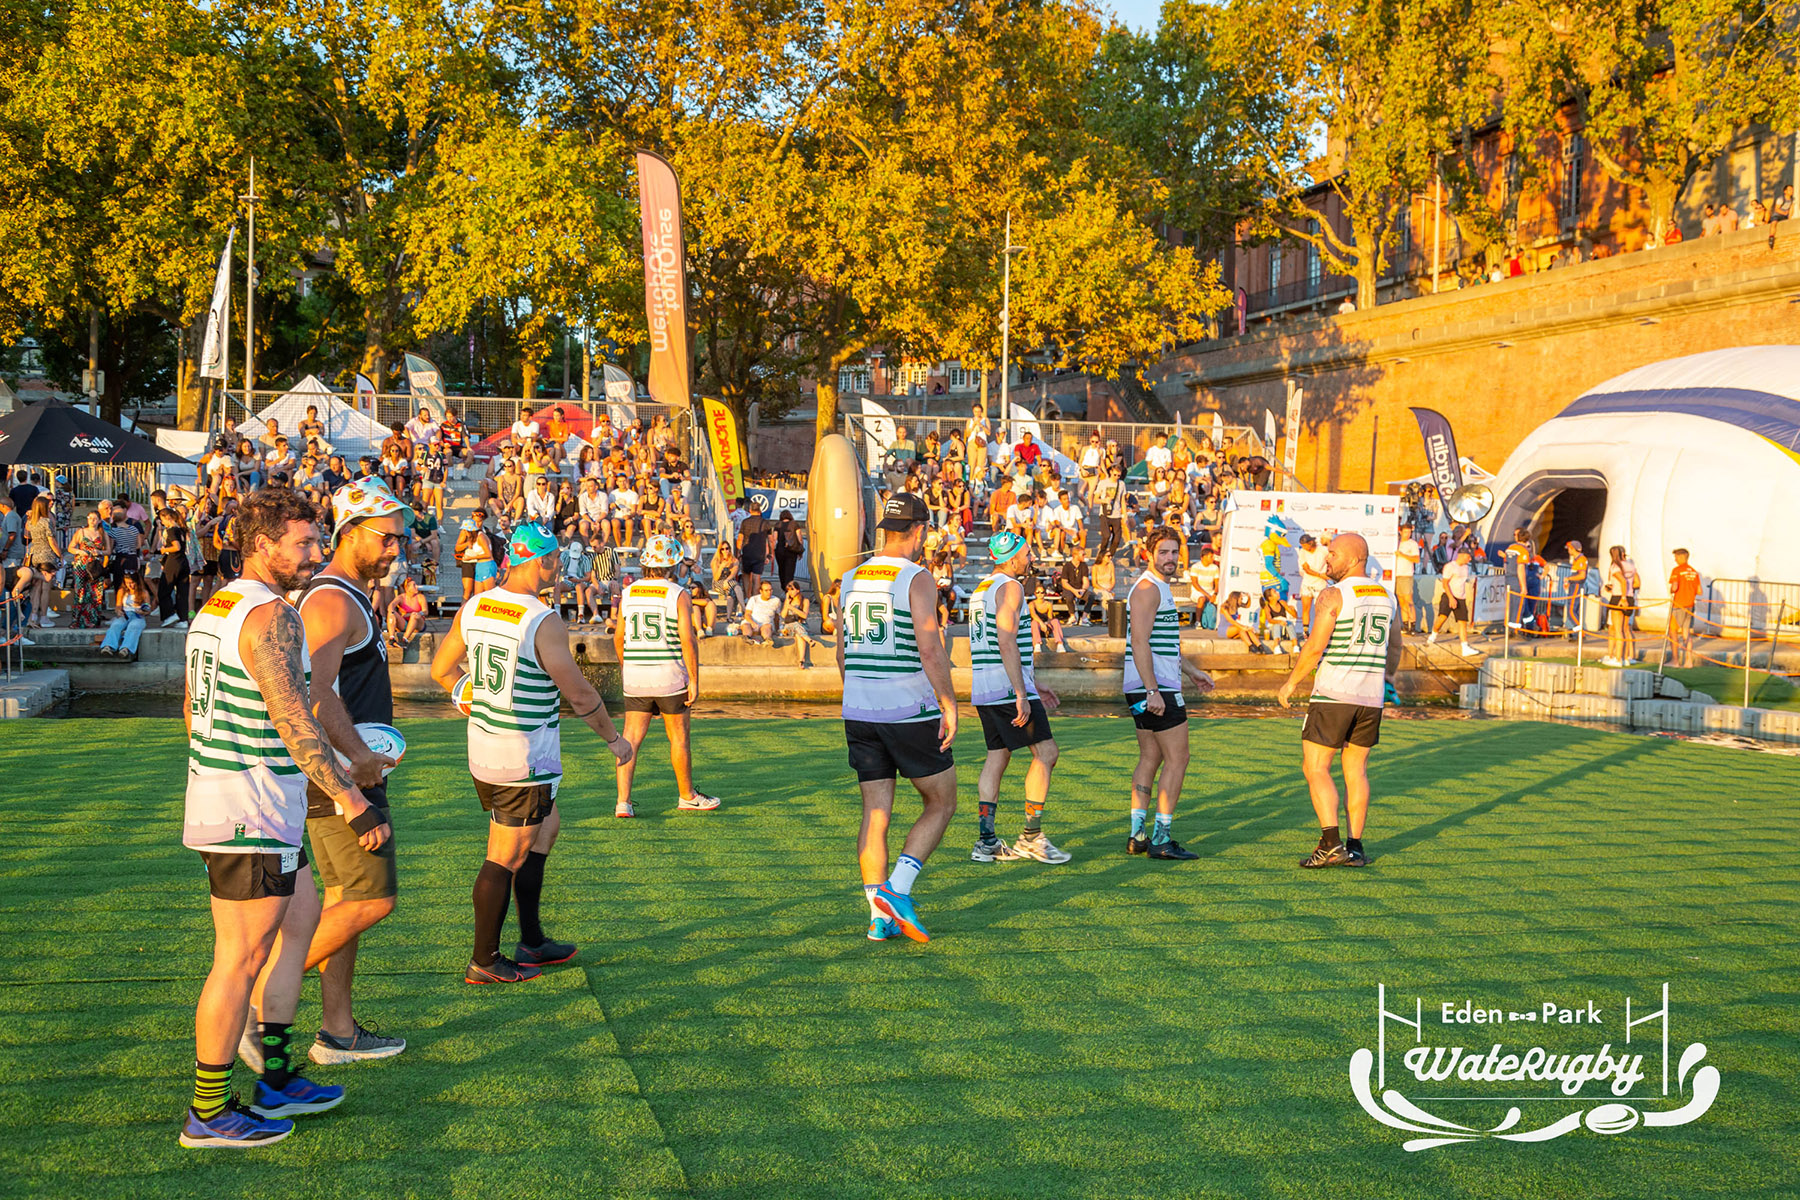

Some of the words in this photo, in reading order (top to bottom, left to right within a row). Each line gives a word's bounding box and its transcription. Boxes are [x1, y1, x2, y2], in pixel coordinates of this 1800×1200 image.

[70, 436, 114, 448] Asahi
[427, 458, 441, 470] 54
[491, 606, 523, 619] OLYMPIQUE
[630, 612, 663, 642] 15
[850, 602, 887, 645] 15
[1354, 613, 1390, 646] 15
[190, 648, 213, 718] 15
[473, 642, 509, 695] 15
